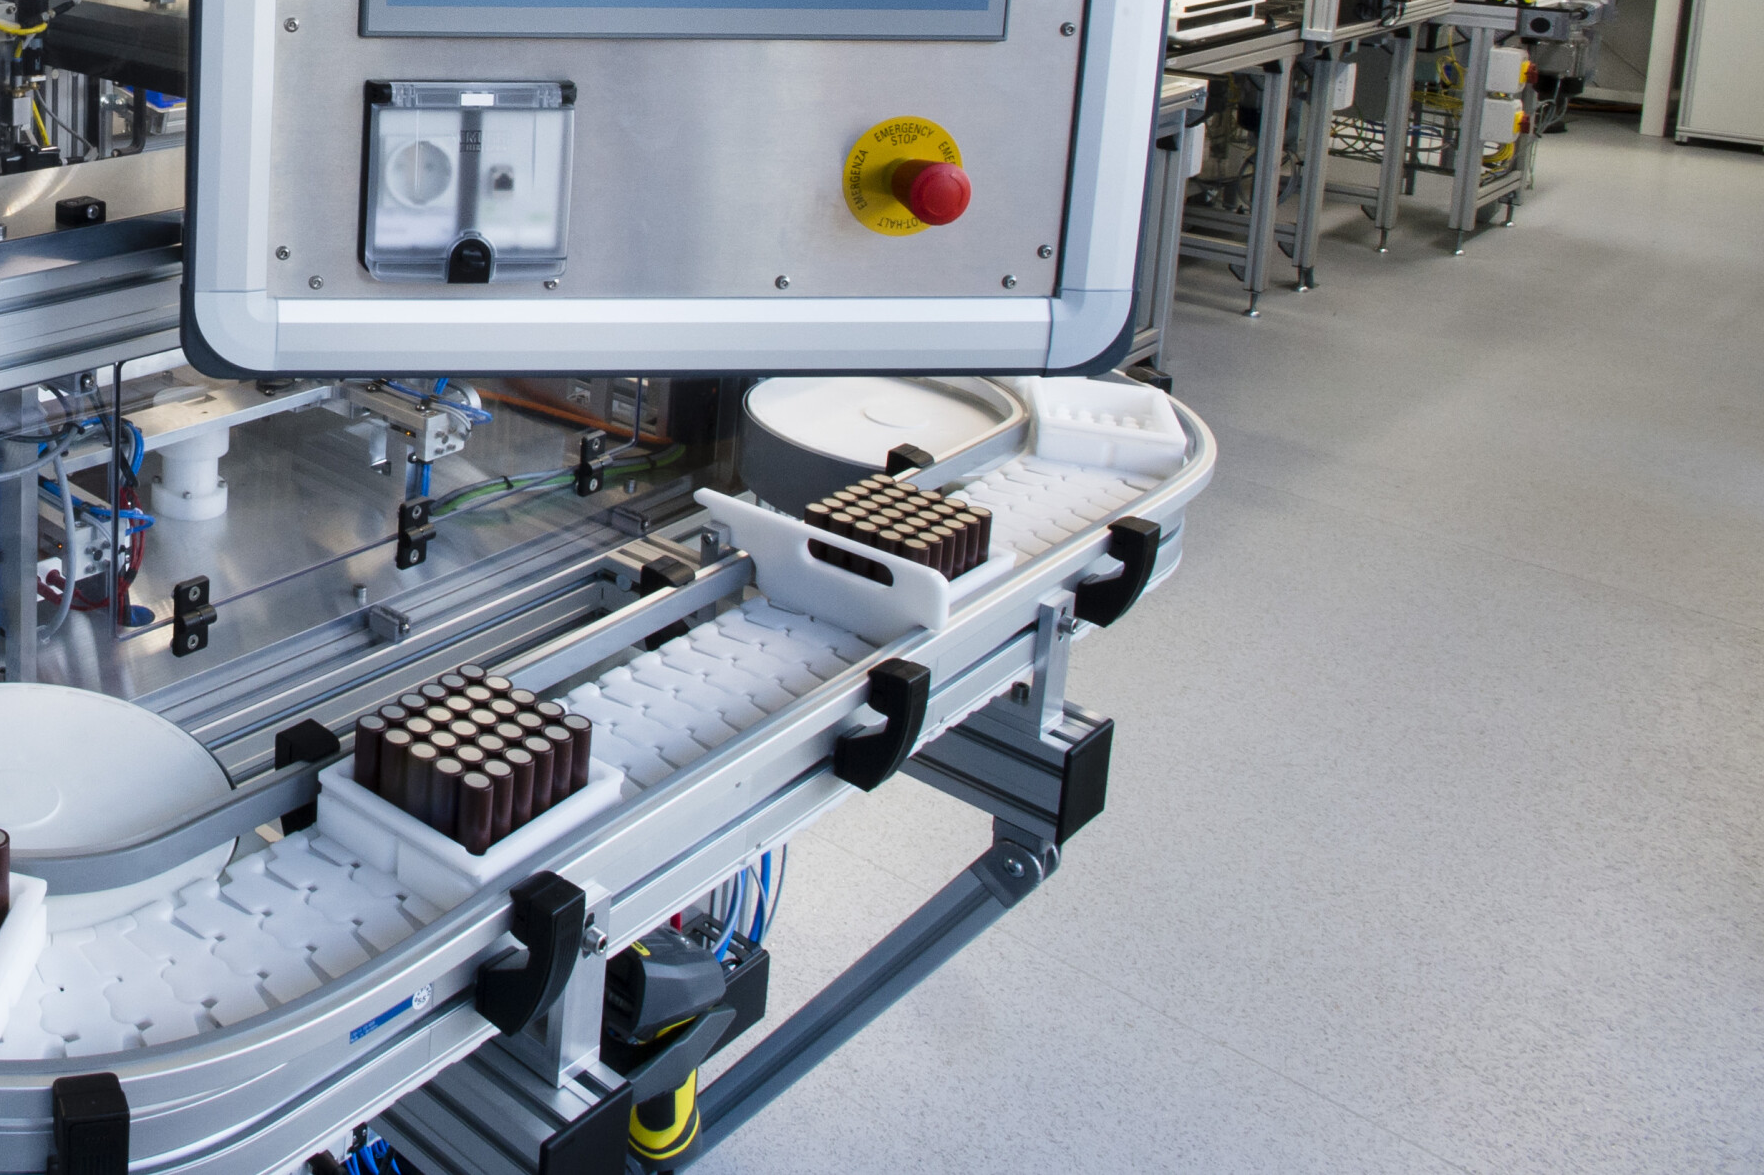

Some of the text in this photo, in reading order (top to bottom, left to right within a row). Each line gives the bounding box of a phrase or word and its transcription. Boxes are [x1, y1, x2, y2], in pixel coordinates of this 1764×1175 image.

[874, 122, 935, 143] EMERGENCY
[891, 134, 918, 146] STOP
[849, 149, 869, 211] EMERGENZA
[877, 217, 922, 229] OT-HALT
